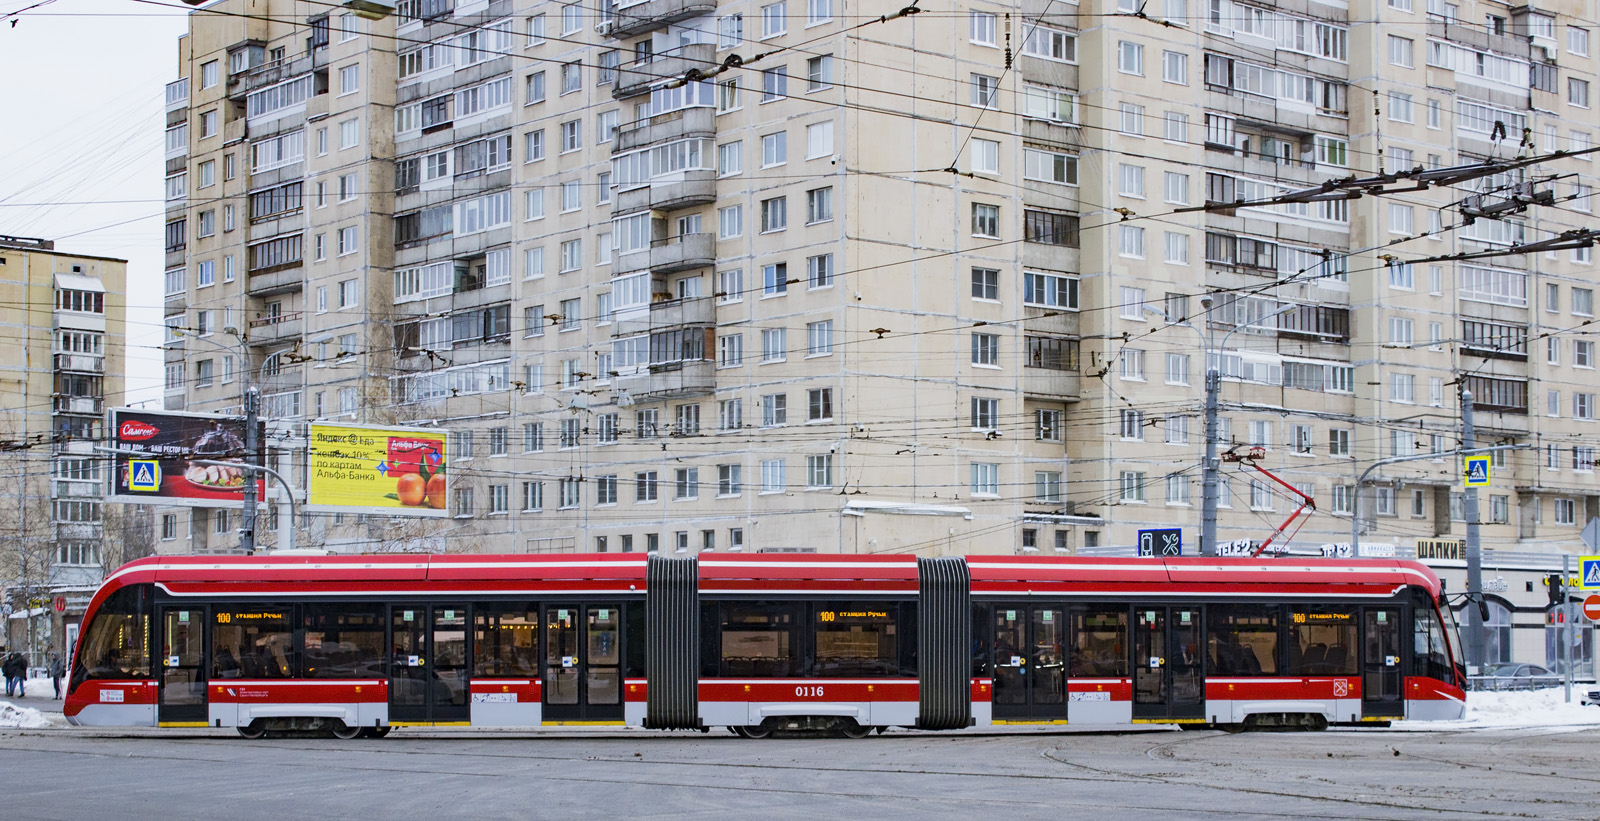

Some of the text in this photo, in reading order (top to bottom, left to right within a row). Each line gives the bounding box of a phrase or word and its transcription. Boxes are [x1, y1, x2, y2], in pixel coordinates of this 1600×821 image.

[330, 461, 362, 470] картам
[317, 469, 375, 480] Альфа-Банка
[1417, 541, 1458, 559] ШАПКИ
[217, 612, 231, 623] 100
[820, 611, 835, 622] 100
[1293, 613, 1306, 623] 100
[795, 686, 824, 697] 0116
